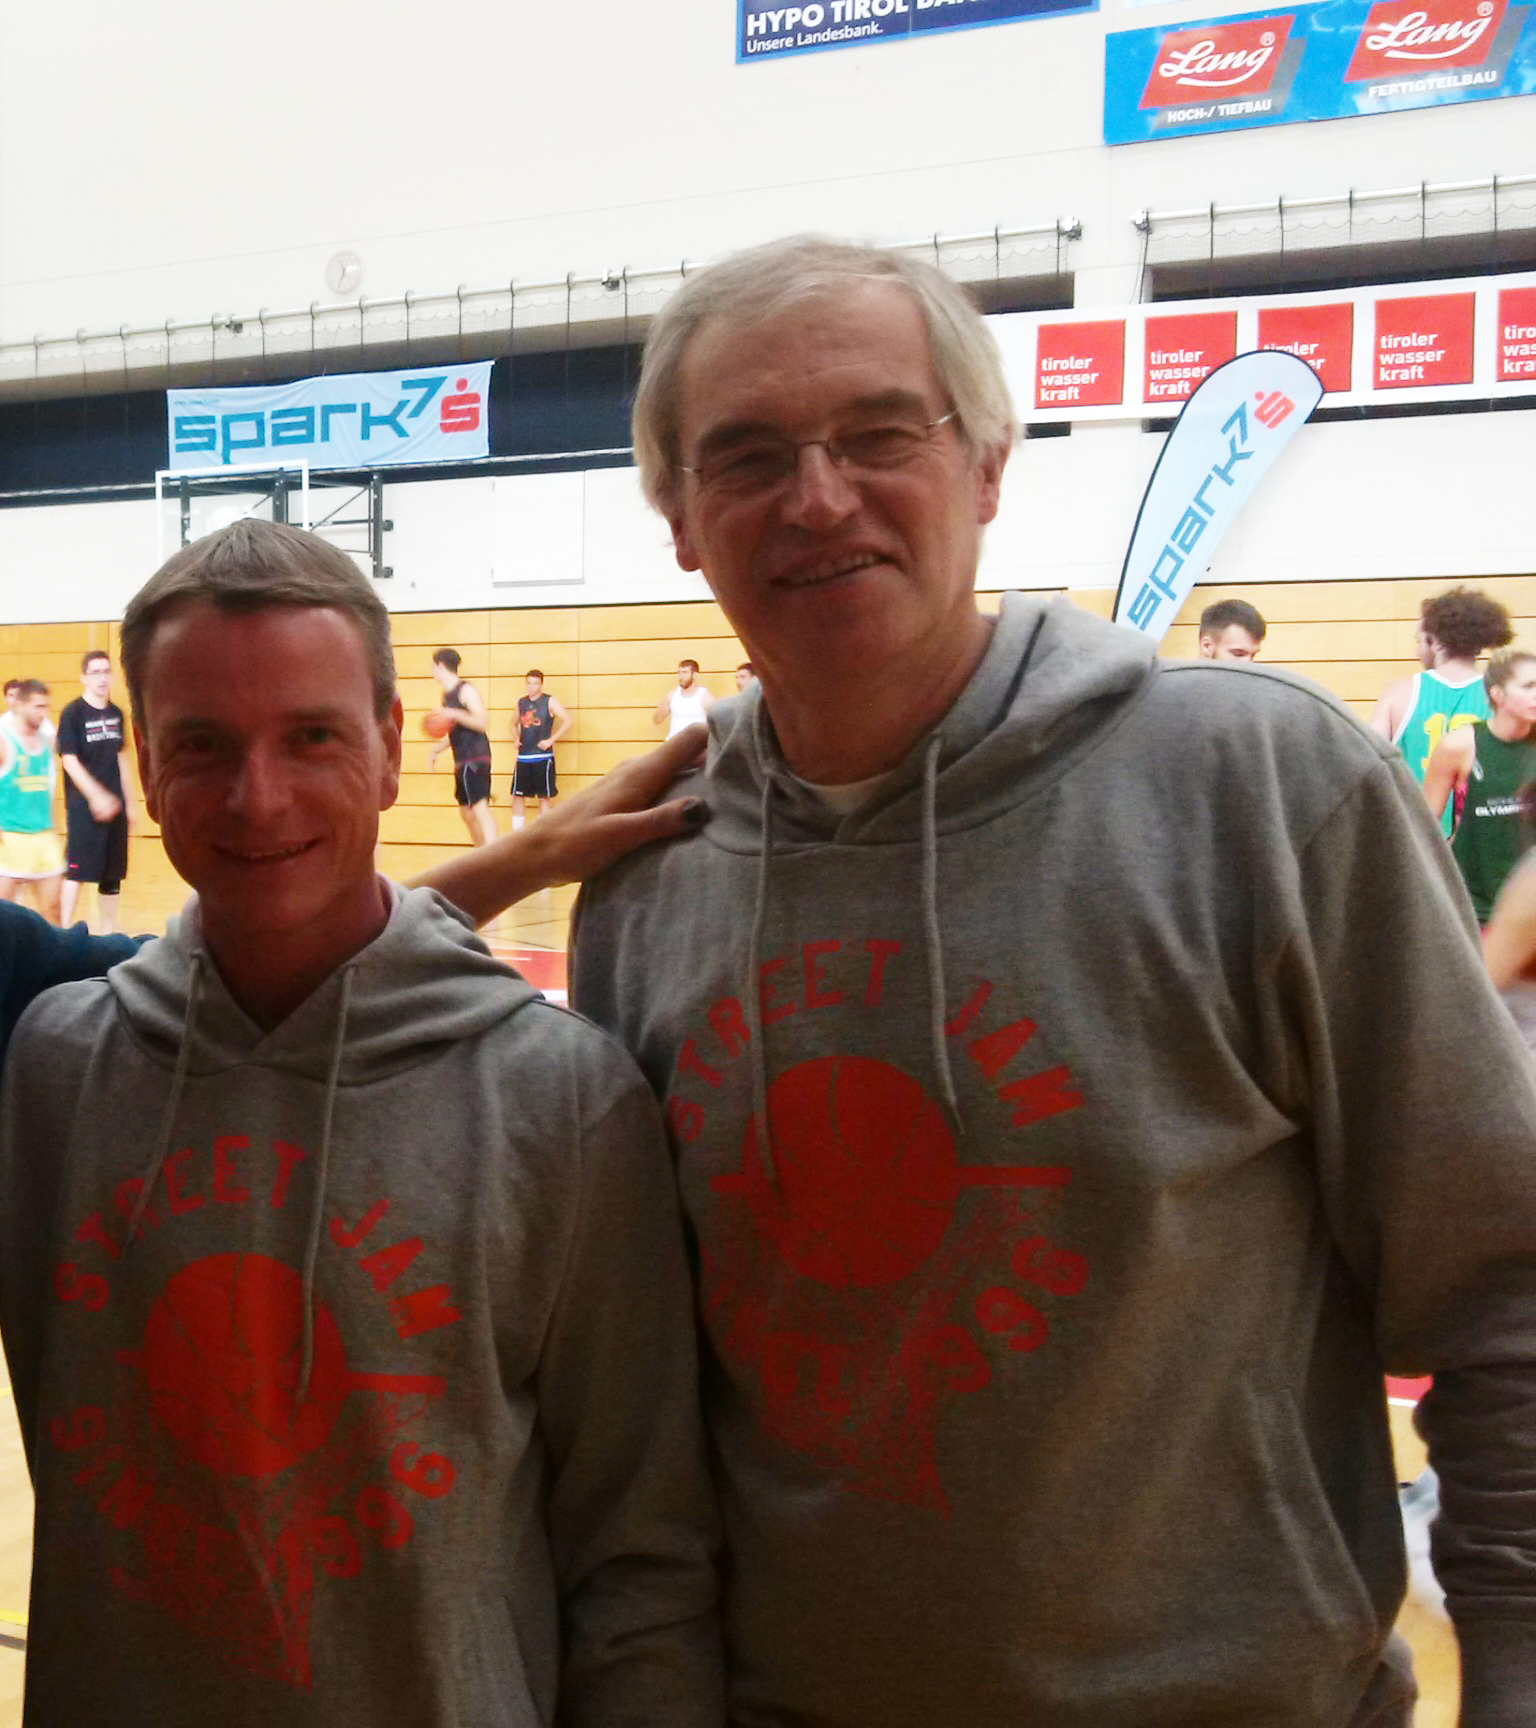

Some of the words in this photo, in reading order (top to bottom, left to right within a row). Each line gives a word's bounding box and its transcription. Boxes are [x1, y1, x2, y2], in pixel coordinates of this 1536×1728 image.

[747, 4, 824, 36] HYPO
[747, 37, 794, 53] Unsere
[797, 21, 884, 46] Landesbank.
[1365, 11, 1493, 60] Lang
[1159, 40, 1275, 87] Lang
[1368, 70, 1497, 98] FERTIGTEILBAU
[1218, 99, 1272, 117] TIEFBAU
[1380, 332, 1438, 349] tiroler
[1041, 353, 1093, 371] tiroler
[1150, 349, 1203, 365] tiroler
[1379, 349, 1445, 365] wasser
[1041, 371, 1099, 386] wasser
[1150, 364, 1210, 380] wasser
[1380, 365, 1424, 381] kraft
[1041, 386, 1080, 401] kraft
[1149, 380, 1191, 396] kraft
[175, 376, 448, 464] spark7
[669, 940, 901, 1142] STREET
[944, 980, 1085, 1128] JAM
[53, 1135, 306, 1312] STREET
[328, 1199, 462, 1339] JAM
